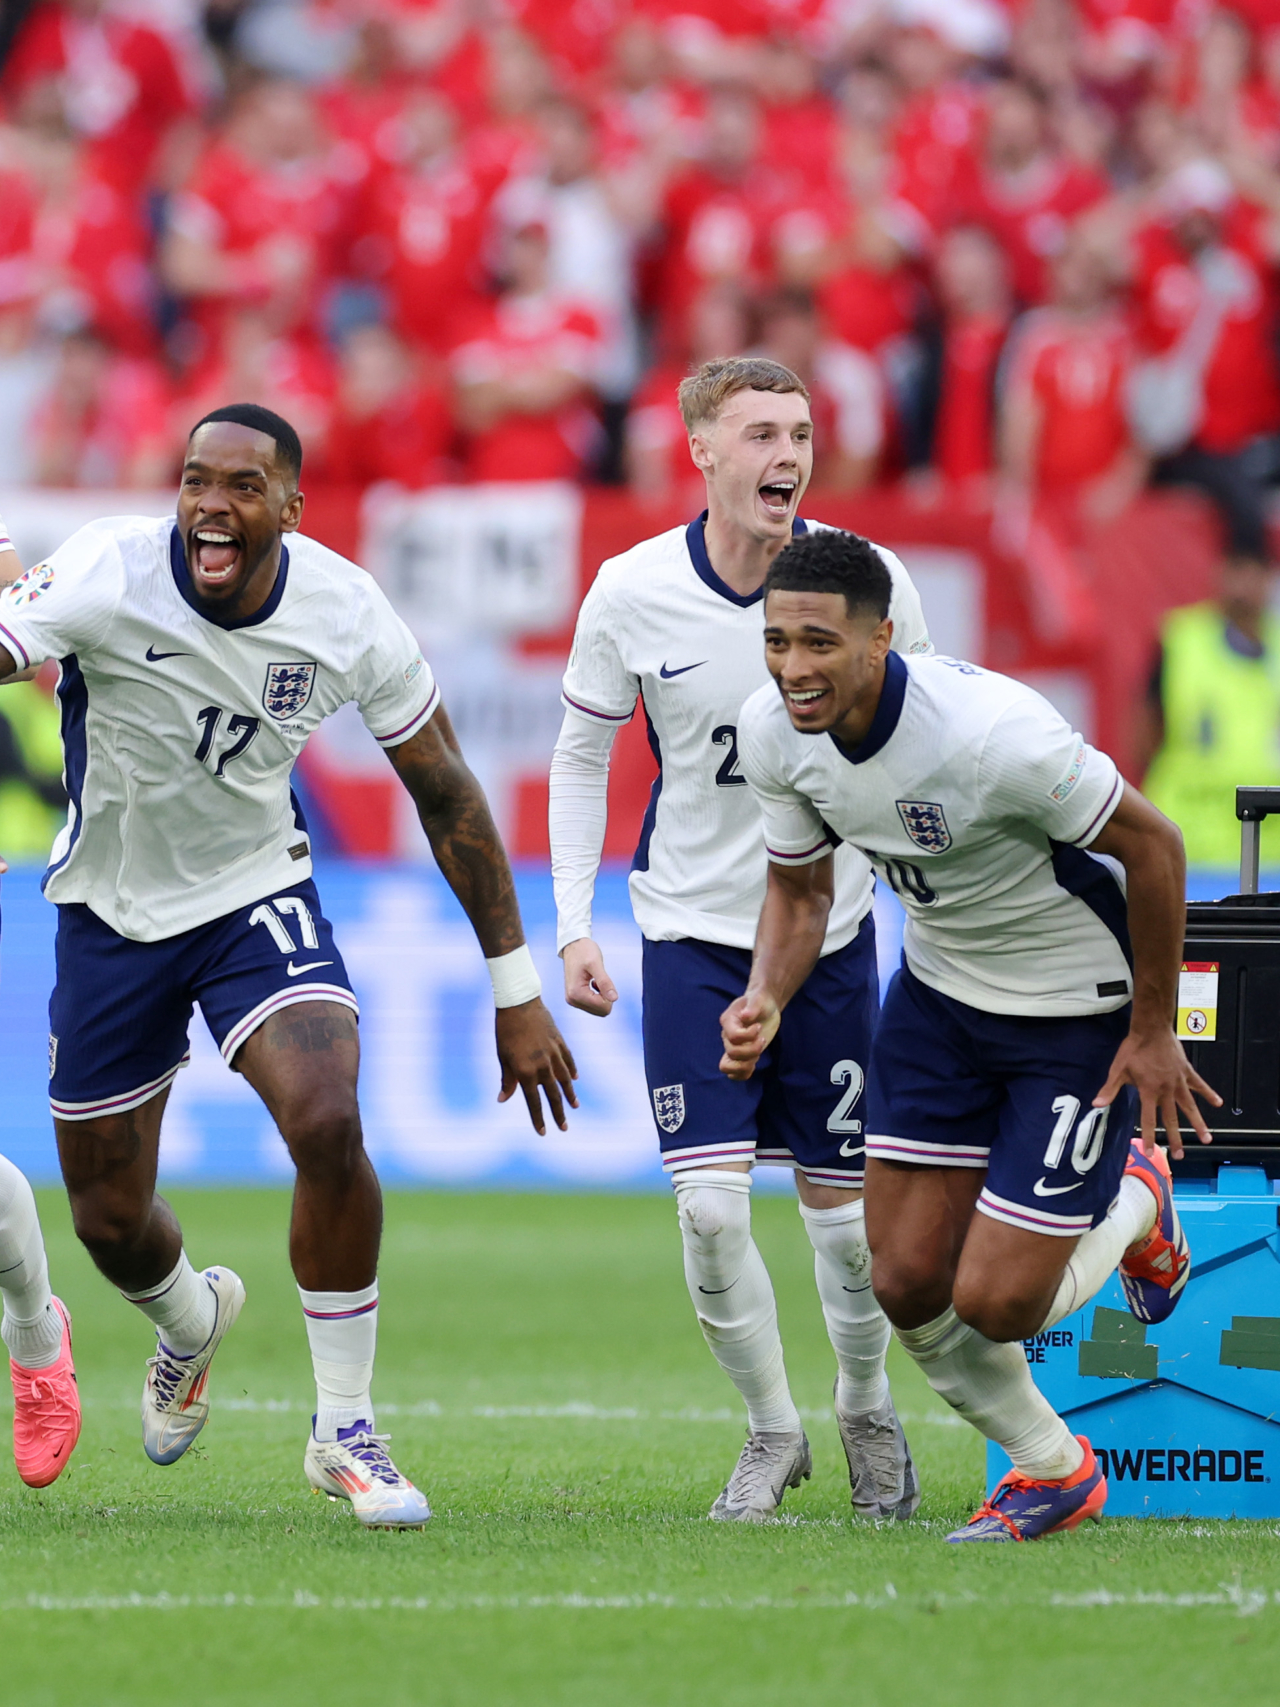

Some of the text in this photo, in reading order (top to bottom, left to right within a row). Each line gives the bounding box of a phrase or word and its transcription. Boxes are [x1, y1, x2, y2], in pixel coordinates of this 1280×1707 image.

[194, 706, 261, 779] 17
[248, 896, 319, 954] 17
[1043, 1094, 1111, 1176] 10
[1021, 1331, 1074, 1347] OWER
[1024, 1347, 1046, 1363] DE
[1091, 1448, 1266, 1482] OWERADE
